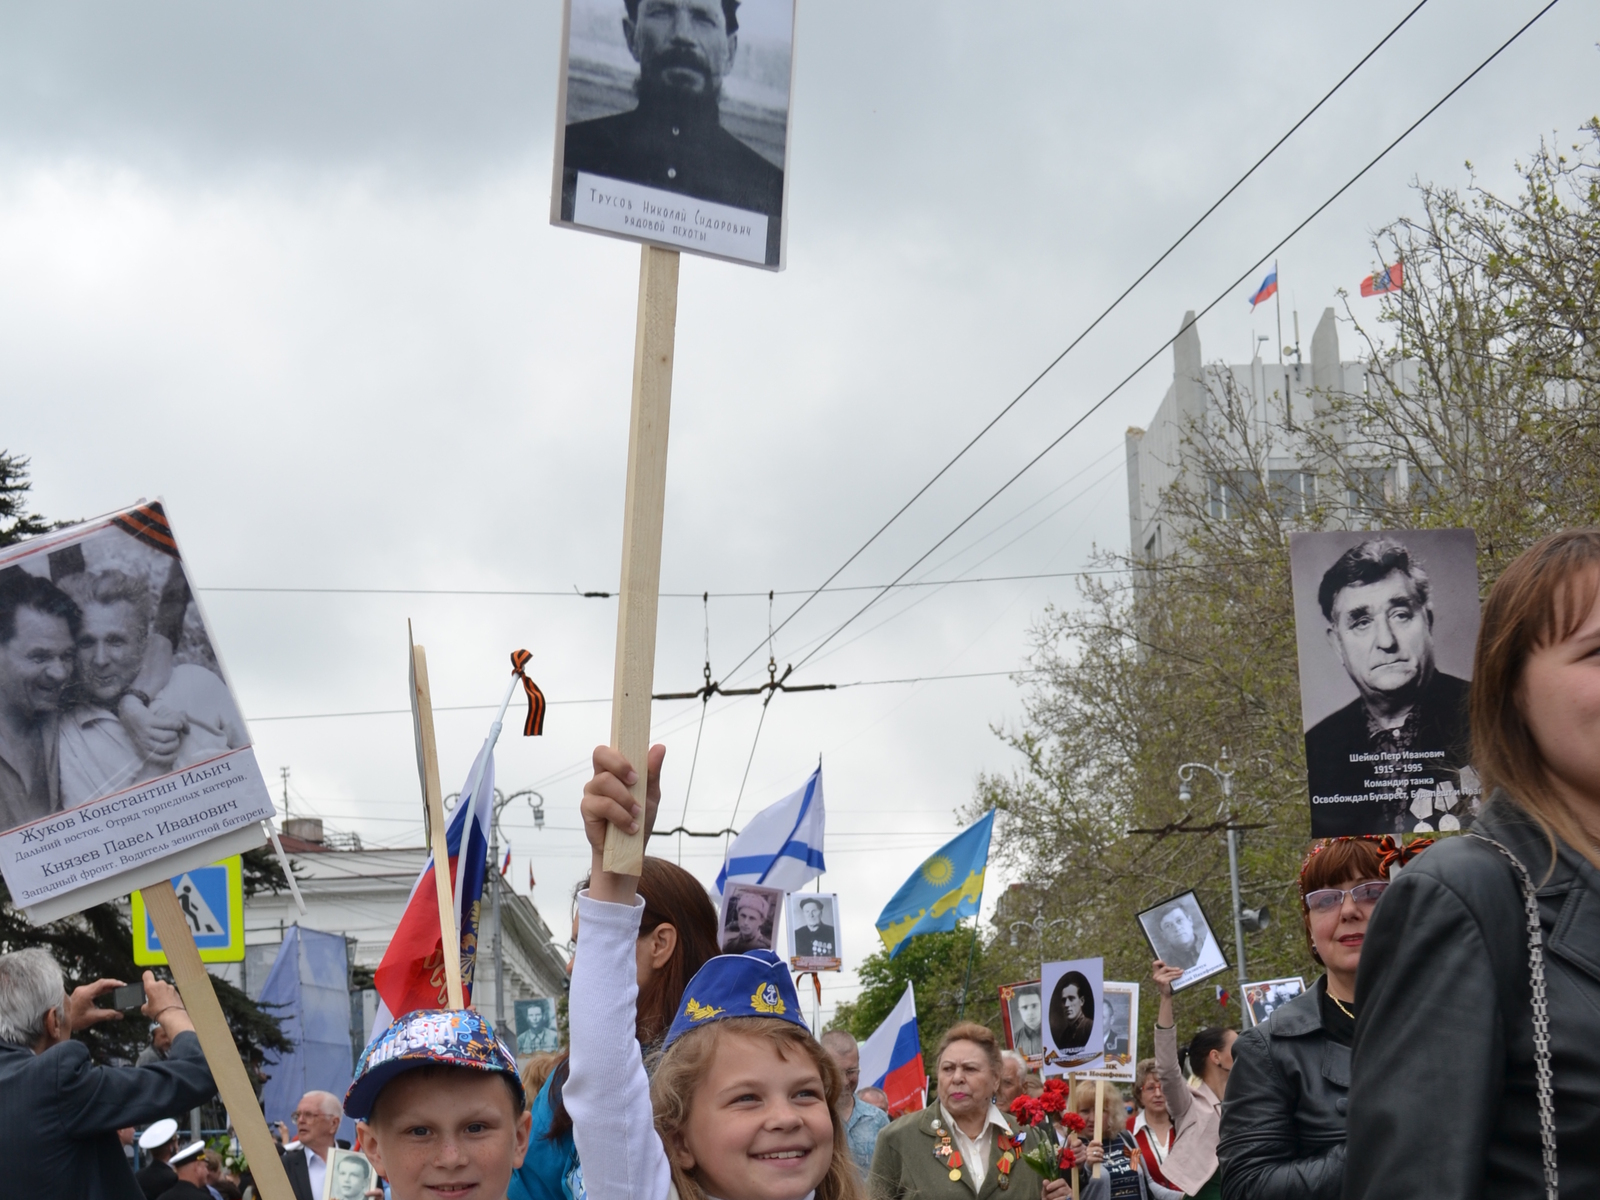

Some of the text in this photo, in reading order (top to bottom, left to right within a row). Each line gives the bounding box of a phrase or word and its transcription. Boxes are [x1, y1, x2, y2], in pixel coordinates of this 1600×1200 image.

[1349, 750, 1446, 763] Шейко Петр Иванович
[1373, 764, 1395, 775] 1915
[1402, 763, 1424, 773] 1995
[19, 761, 232, 845] Жуков Константин Ильич
[1312, 793, 1369, 805] Освобождал
[1369, 791, 1410, 803] Бухарест,
[1462, 787, 1483, 796] Праг
[1363, 777, 1435, 788] Командир танка
[14, 774, 248, 863] Дальний восток. Отряд торпедных катеров.
[41, 799, 238, 878] Князев Павел Иванович
[22, 807, 268, 900] Западный фронт. Водитель зенитной батареи.
